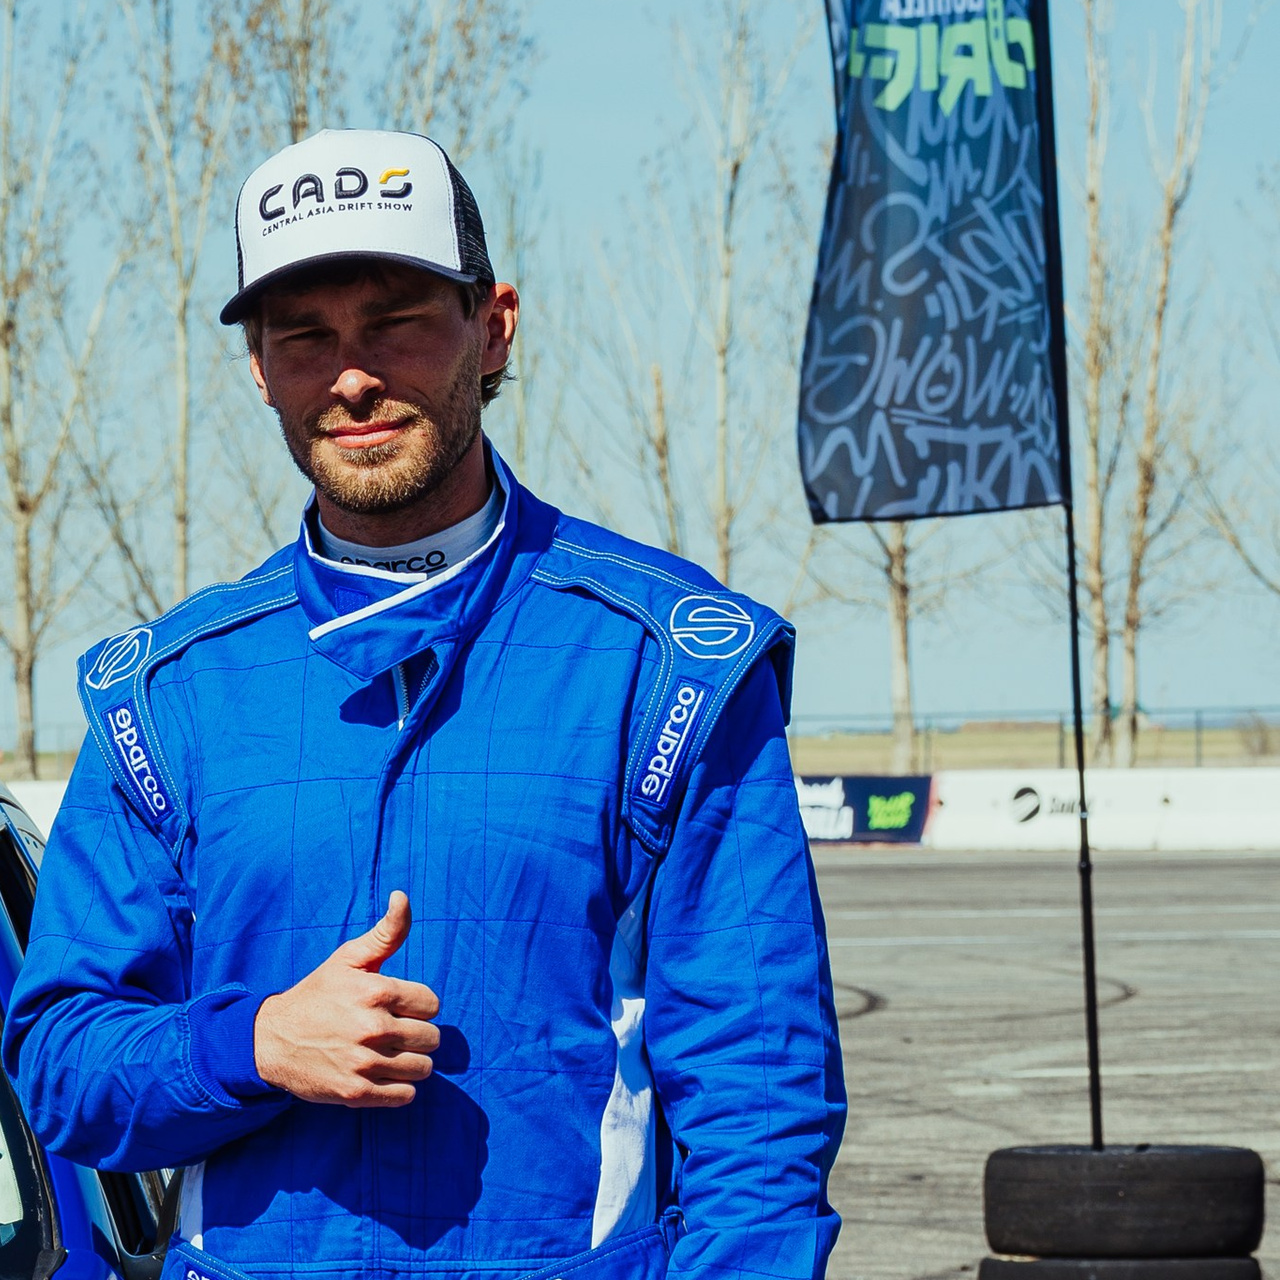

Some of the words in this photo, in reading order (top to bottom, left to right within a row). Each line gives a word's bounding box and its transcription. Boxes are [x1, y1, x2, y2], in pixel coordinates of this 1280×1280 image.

[258, 166, 413, 222] CADS
[261, 213, 304, 237] CENTRAL
[306, 205, 334, 219] ASIA
[338, 202, 373, 212] DRIFT
[376, 202, 413, 212] SHOW
[111, 707, 167, 814] sparco
[641, 686, 699, 798] sparco
